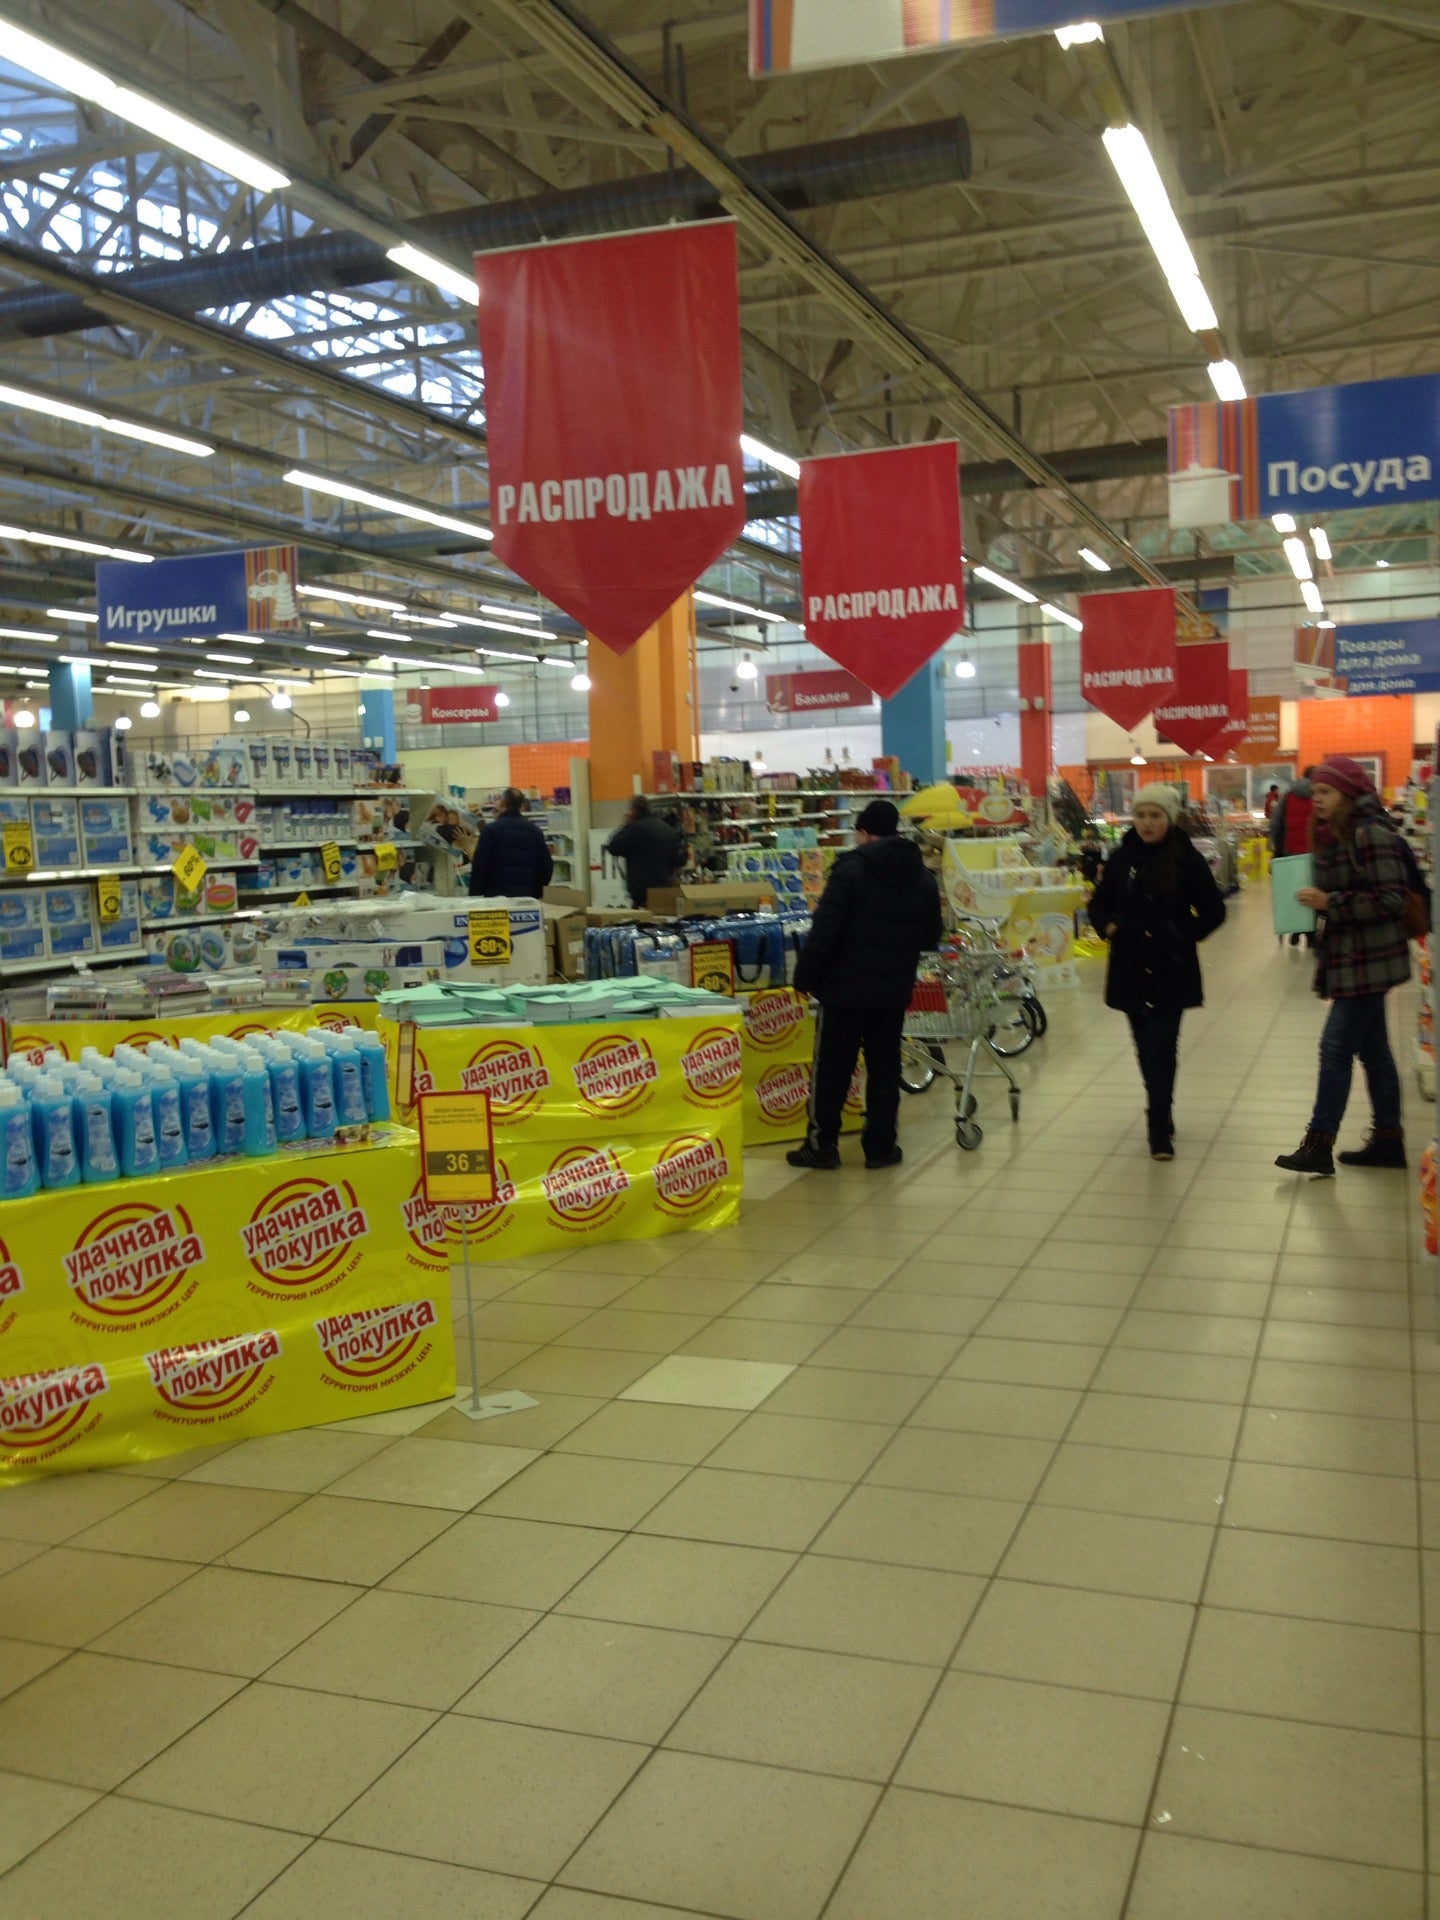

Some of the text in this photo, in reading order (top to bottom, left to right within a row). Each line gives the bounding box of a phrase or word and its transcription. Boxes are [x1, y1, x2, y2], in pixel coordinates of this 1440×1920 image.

[498, 464, 734, 525] РАСПРОДАЖА
[1268, 455, 1431, 497] Посуда
[107, 605, 217, 633] Игрушки
[809, 583, 958, 622] РАСПРОДАЖА
[1337, 639, 1404, 653] Товары
[1337, 654, 1421, 671] для дома
[1084, 667, 1174, 688] РАСПРОДАЖА
[1377, 679, 1416, 691] дома
[432, 708, 489, 720] Консервы
[795, 692, 850, 705] Бакалея
[1155, 704, 1229, 720] РАСПРОДАЖА
[509, 912, 537, 922] NTEX
[462, 1051, 532, 1089] удачная
[574, 1044, 641, 1084] удачная
[681, 1035, 741, 1076] удачная
[695, 1058, 742, 1087] покупк
[485, 1069, 549, 1101] окупка
[588, 1061, 657, 1096] покупка
[446, 1153, 469, 1172] 36
[543, 1155, 610, 1196] удачная
[654, 1144, 715, 1185] удачная
[665, 1160, 728, 1195] покупка
[558, 1171, 629, 1209] покупка
[243, 1188, 342, 1254] удачная
[66, 1213, 175, 1284] удачная
[264, 1212, 367, 1269] покупка
[89, 1237, 203, 1298] покупка
[246, 1252, 364, 1301] ТЕРРИТОРИЯ НИЗКИХ ЦЕН
[406, 1252, 449, 1272] ТЕРРИТОР
[69, 1281, 200, 1333] ТЕРРИТОРИЯ НИЗКИХ ЦЕН
[337, 1300, 435, 1363] покупка
[171, 1331, 280, 1397] покупка
[319, 1342, 433, 1393] ТЕРРИТОРИЯ НИЗКИХ ЦЕН
[0, 1366, 105, 1426] окупка
[152, 1408, 215, 1426] ТЕРРИТОРИЯ
